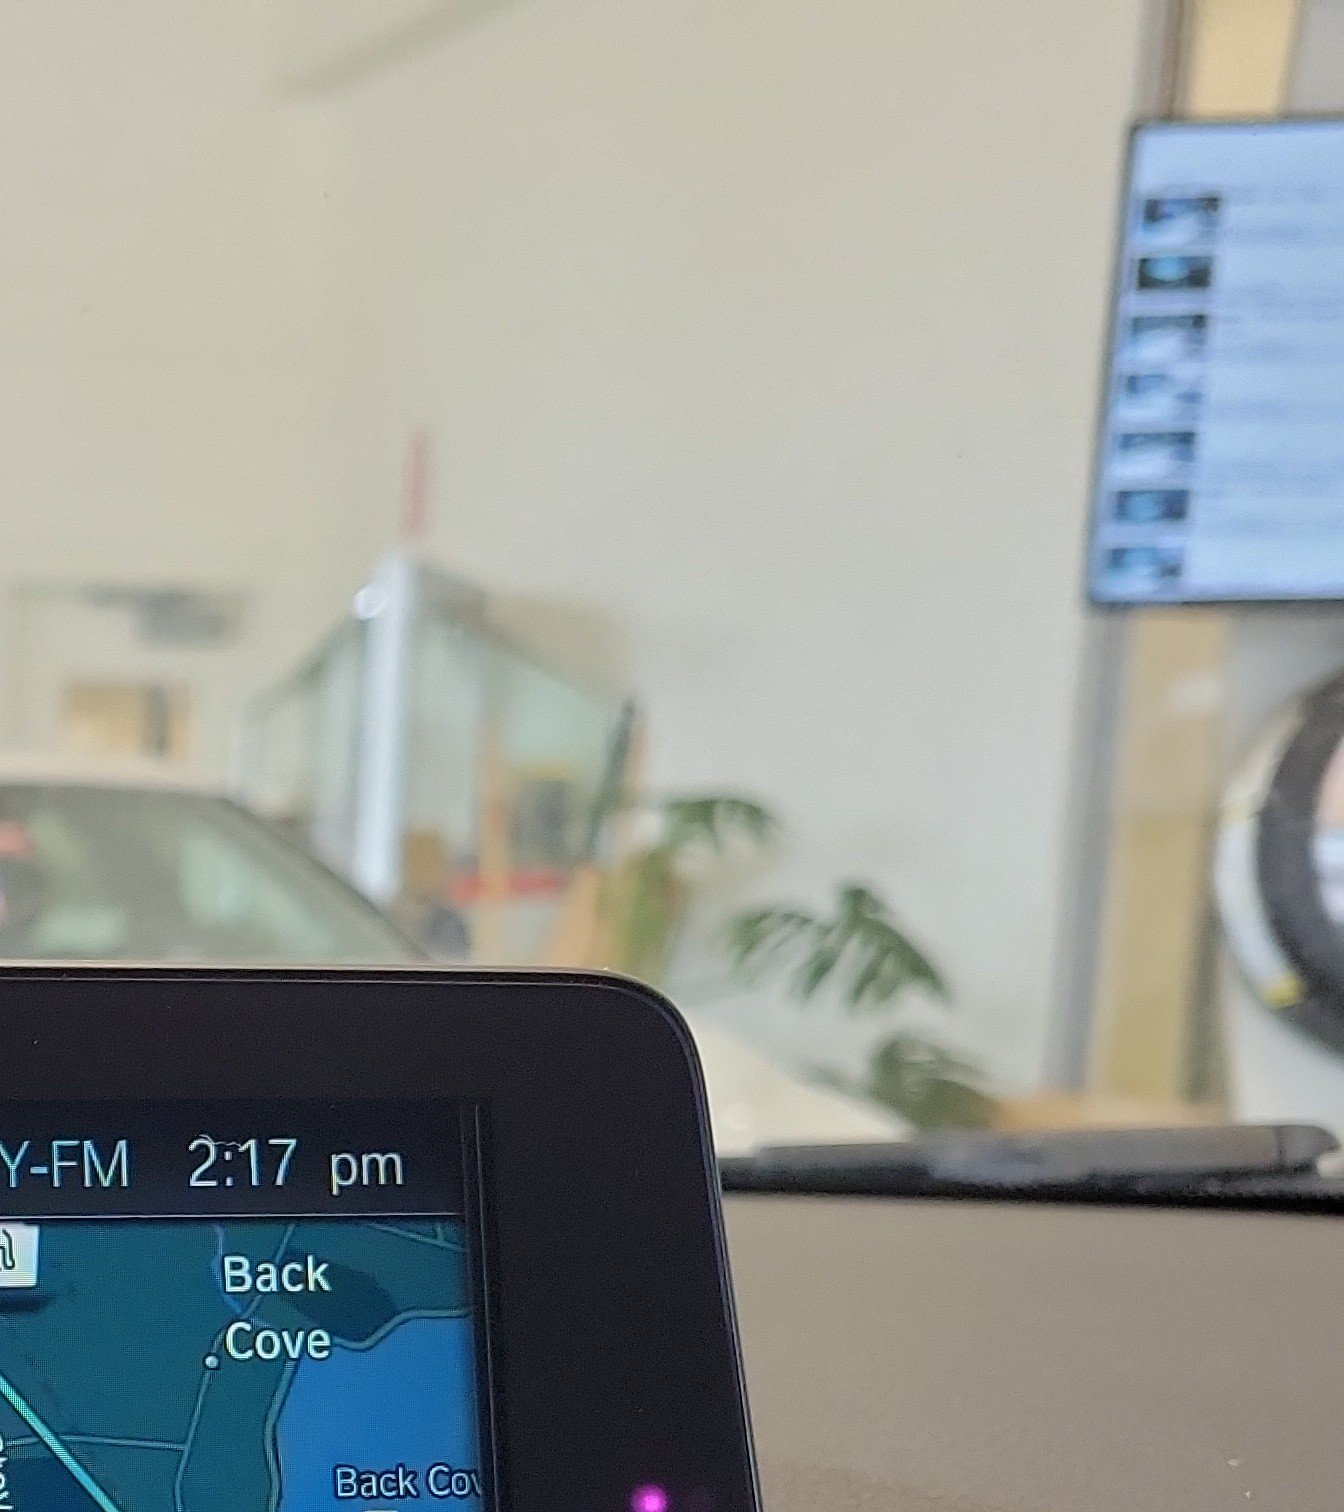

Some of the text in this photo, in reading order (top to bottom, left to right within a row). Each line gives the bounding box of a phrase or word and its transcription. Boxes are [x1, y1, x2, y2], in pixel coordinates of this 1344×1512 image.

[189, 1138, 404, 1196] 2:17 pm
[222, 1255, 332, 1295] Back
[224, 1322, 332, 1361] Cove
[335, 1465, 418, 1498] Back
